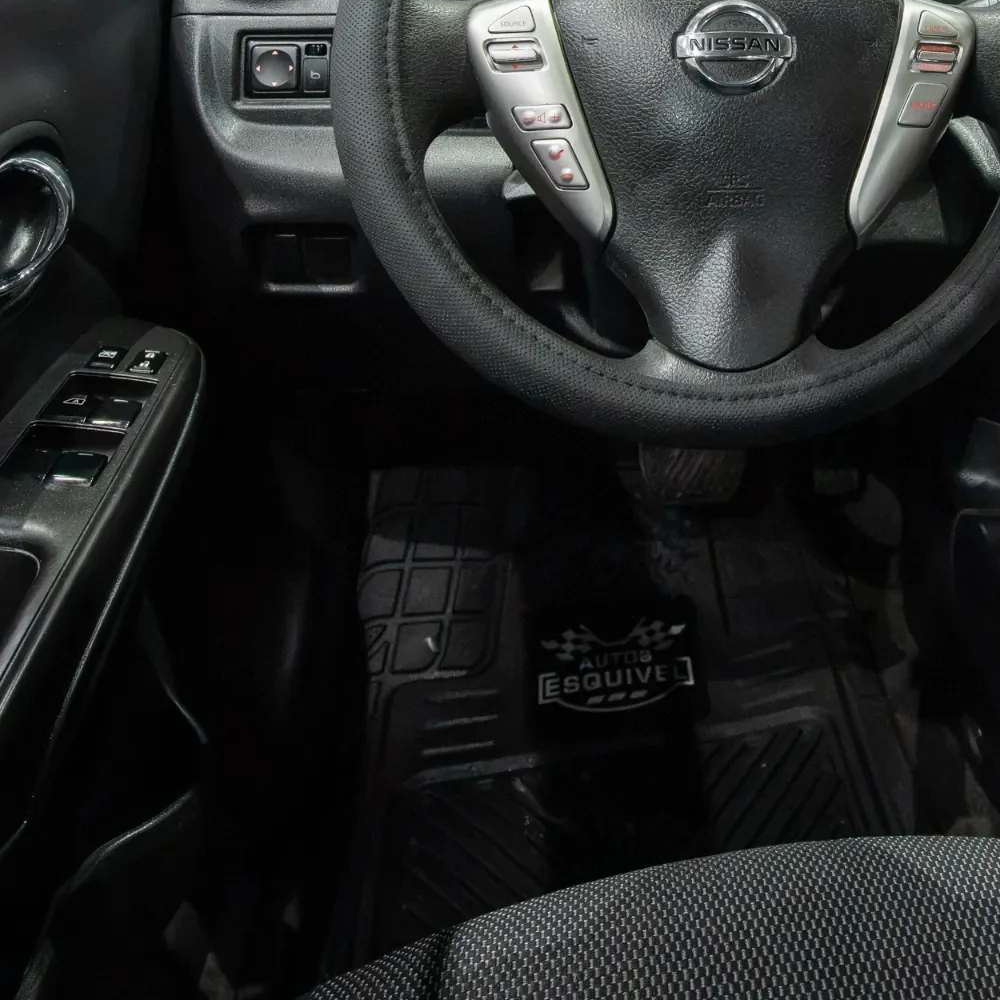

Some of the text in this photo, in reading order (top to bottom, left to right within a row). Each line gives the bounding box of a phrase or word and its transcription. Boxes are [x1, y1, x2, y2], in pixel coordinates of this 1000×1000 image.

[689, 37, 781, 52] NISSAN
[579, 650, 653, 671] AUTOS
[545, 663, 687, 697] ESQUIVEL
